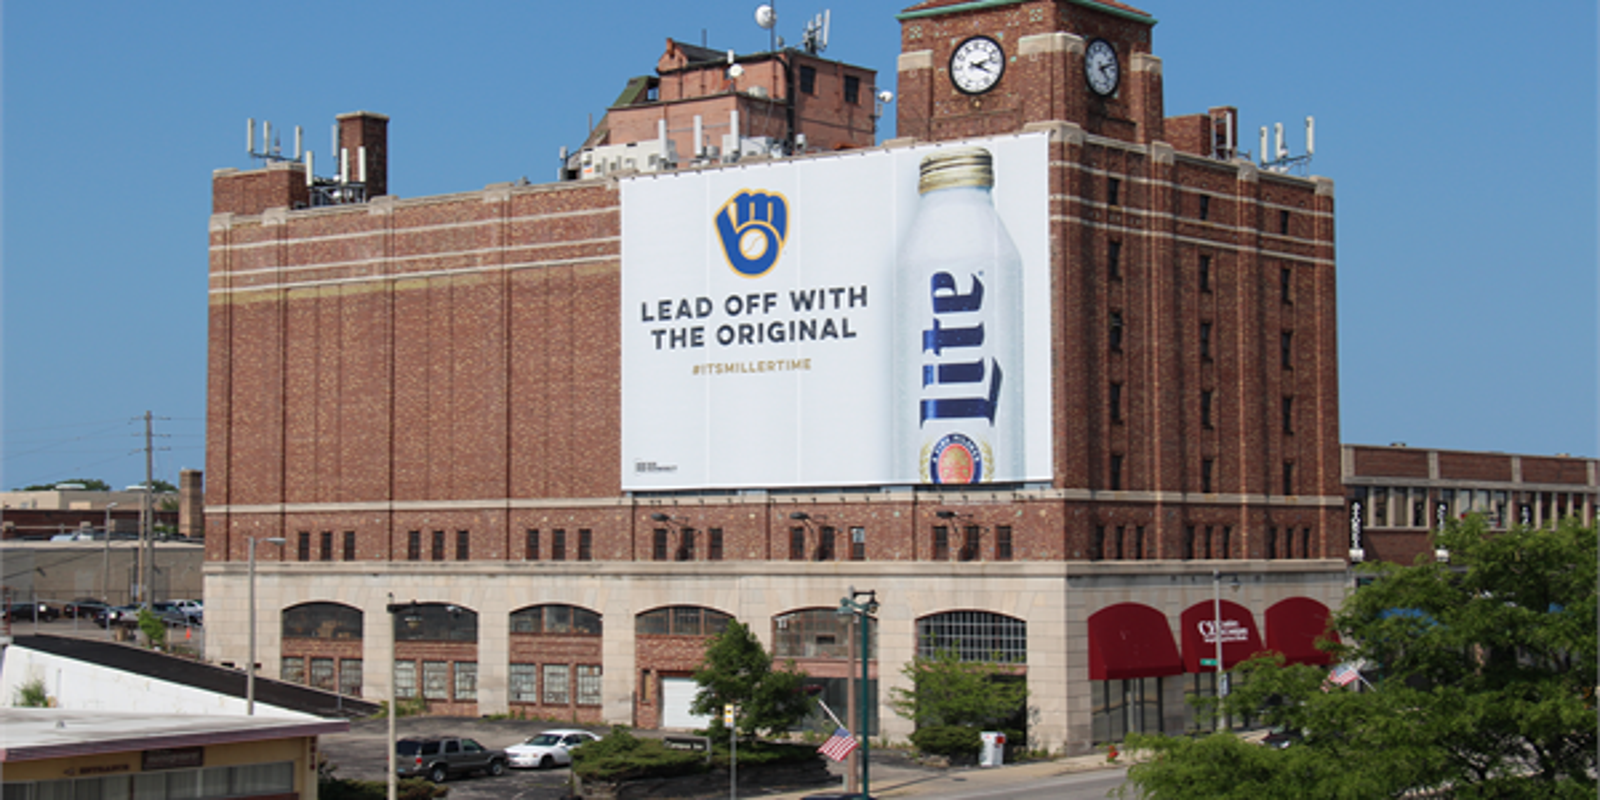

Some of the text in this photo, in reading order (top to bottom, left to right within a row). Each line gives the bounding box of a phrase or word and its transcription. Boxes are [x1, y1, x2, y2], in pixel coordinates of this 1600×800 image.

[641, 285, 868, 322] LEAD OFF WITH
[651, 318, 857, 350] THE ORIGINAL
[919, 271, 1003, 429] Lite
[692, 358, 812, 375] #ITSMILLERTIME
